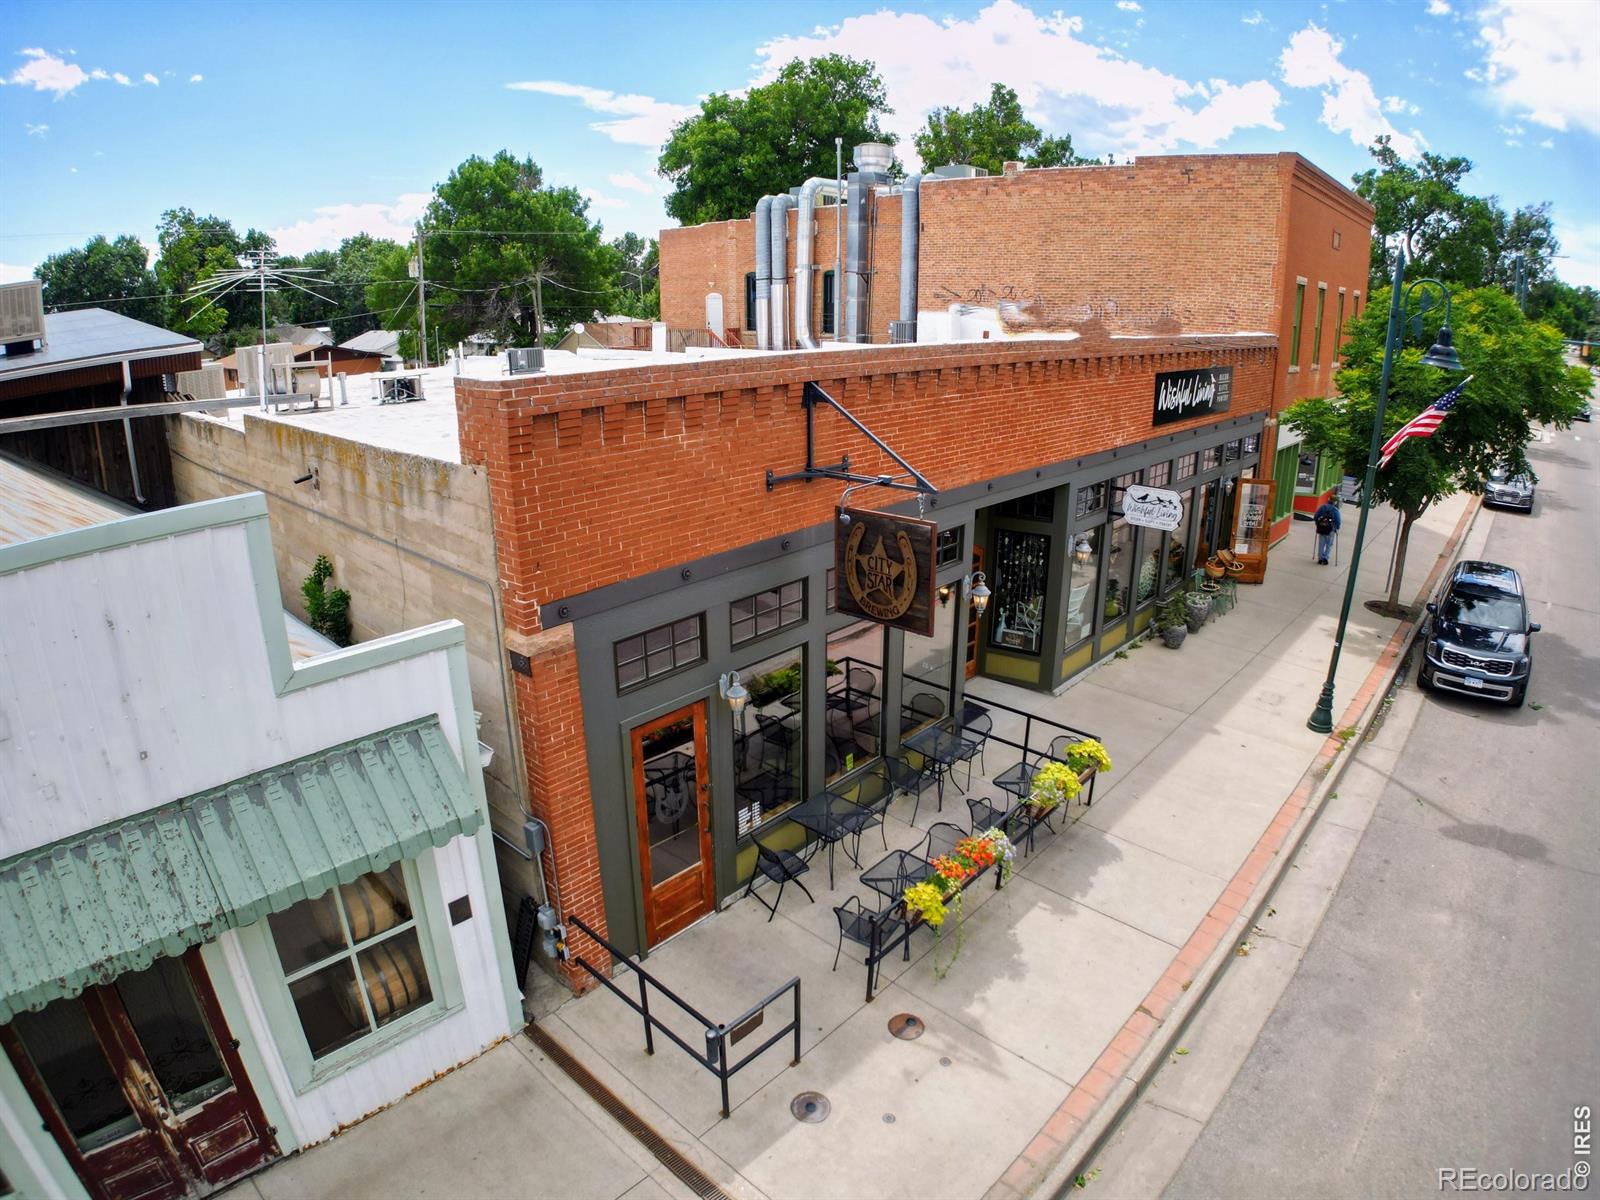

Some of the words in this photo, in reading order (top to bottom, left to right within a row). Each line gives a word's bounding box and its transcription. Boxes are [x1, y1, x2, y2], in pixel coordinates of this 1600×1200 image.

[1158, 378, 1193, 414] Wishful
[1192, 374, 1216, 408] Living
[867, 556, 893, 574] CITY
[867, 572, 894, 596] STAR
[859, 596, 900, 618] BREWING
